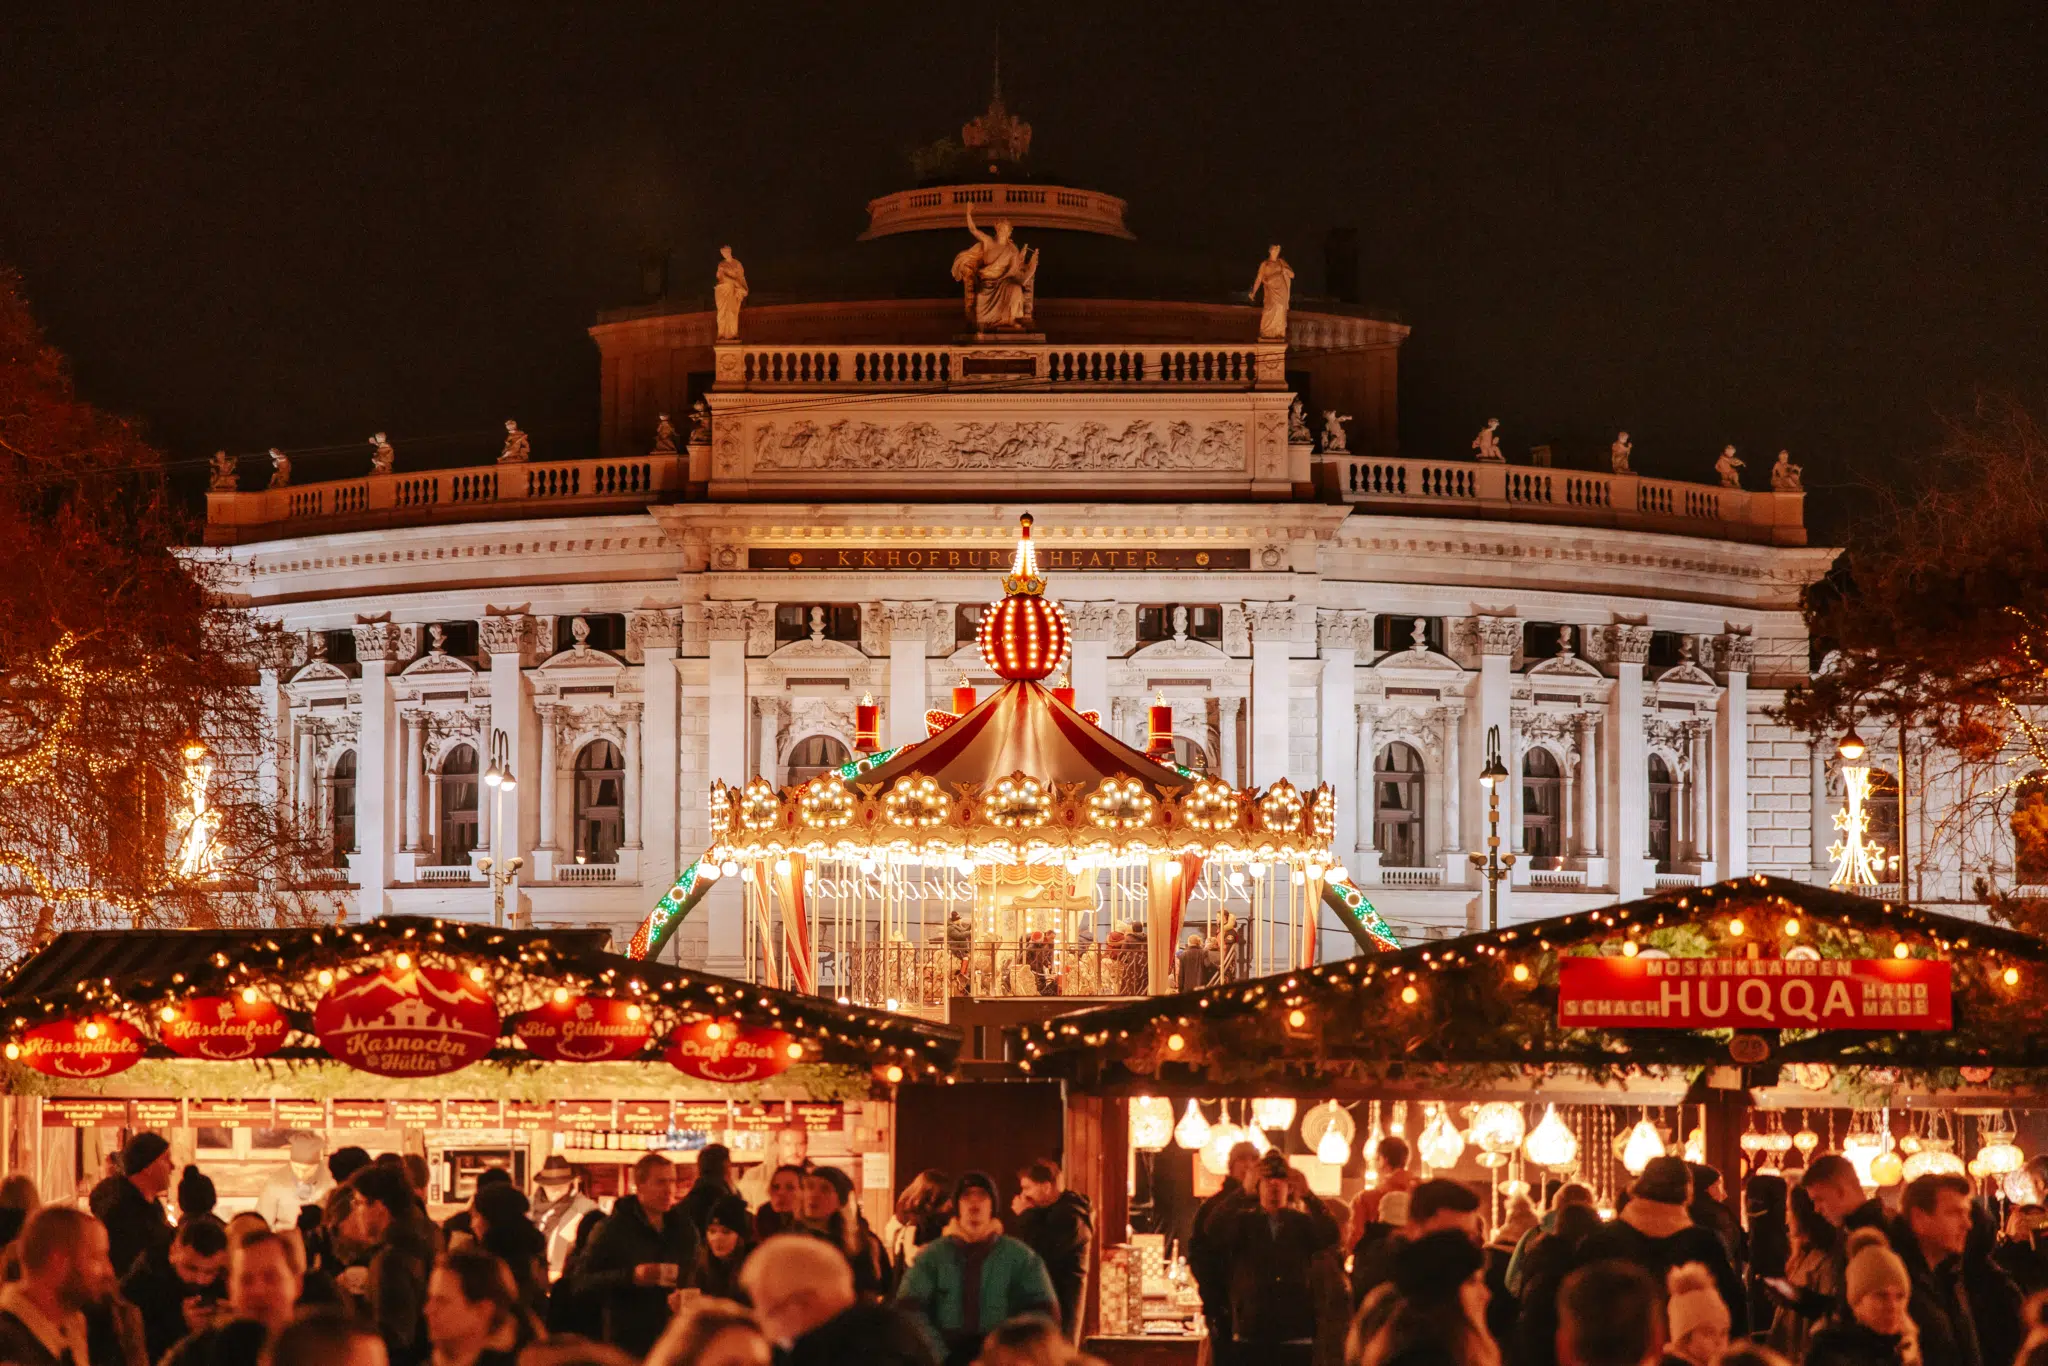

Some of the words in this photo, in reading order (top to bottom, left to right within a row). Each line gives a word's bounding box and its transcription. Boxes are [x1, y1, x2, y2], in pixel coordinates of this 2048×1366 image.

[1646, 960, 1851, 976] MOSAIKLAMPEN
[1660, 979, 1855, 1022] HUQQA
[1862, 983, 1928, 999] HAND
[1563, 1000, 1660, 1016] SCHACH
[1862, 1000, 1929, 1016] MADE
[173, 1020, 283, 1042] Käseteuferl
[517, 1020, 556, 1037] Bio
[562, 1020, 646, 1041] Glühwein
[23, 1037, 140, 1058] Käsespätzle
[346, 1032, 467, 1056] Kasnockn
[681, 1040, 729, 1062] Craft
[733, 1041, 775, 1058] Bier
